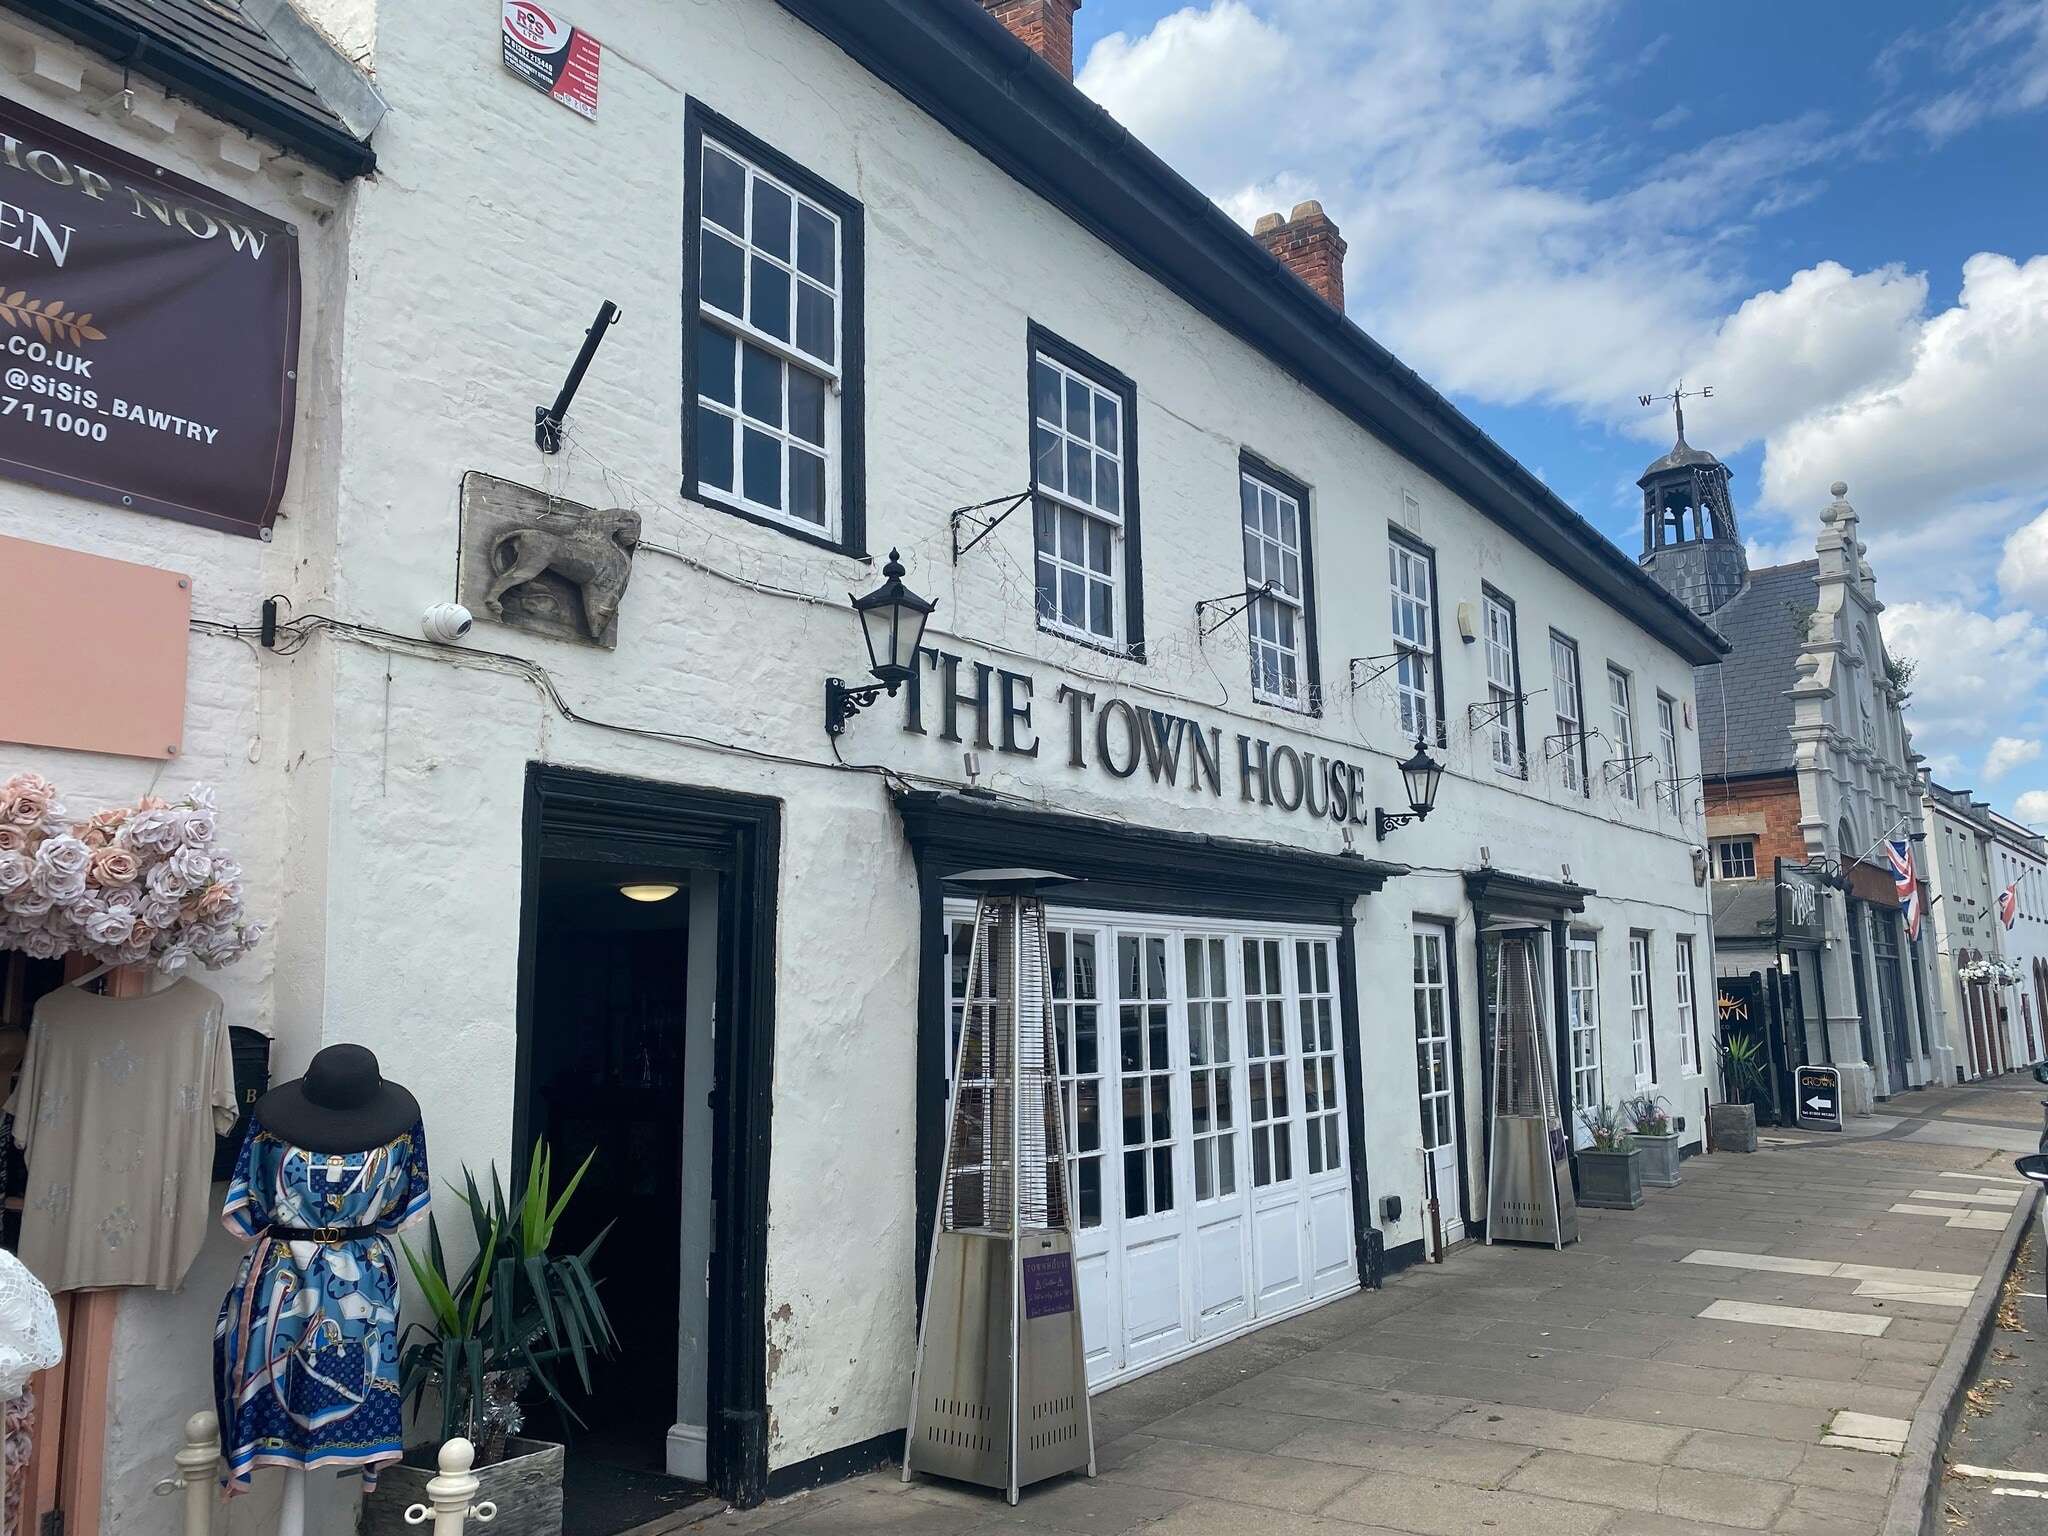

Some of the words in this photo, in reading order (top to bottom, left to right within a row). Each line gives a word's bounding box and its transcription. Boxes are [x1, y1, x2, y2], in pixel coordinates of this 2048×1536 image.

[0, 201, 77, 268] EN
[124, 185, 269, 260] NOW
[1, 395, 108, 442] 711000
[903, 645, 1040, 759] THE
[1057, 683, 1223, 797] TOWN
[1236, 733, 1368, 826] HOUSE
[246, 1088, 257, 1103] B
